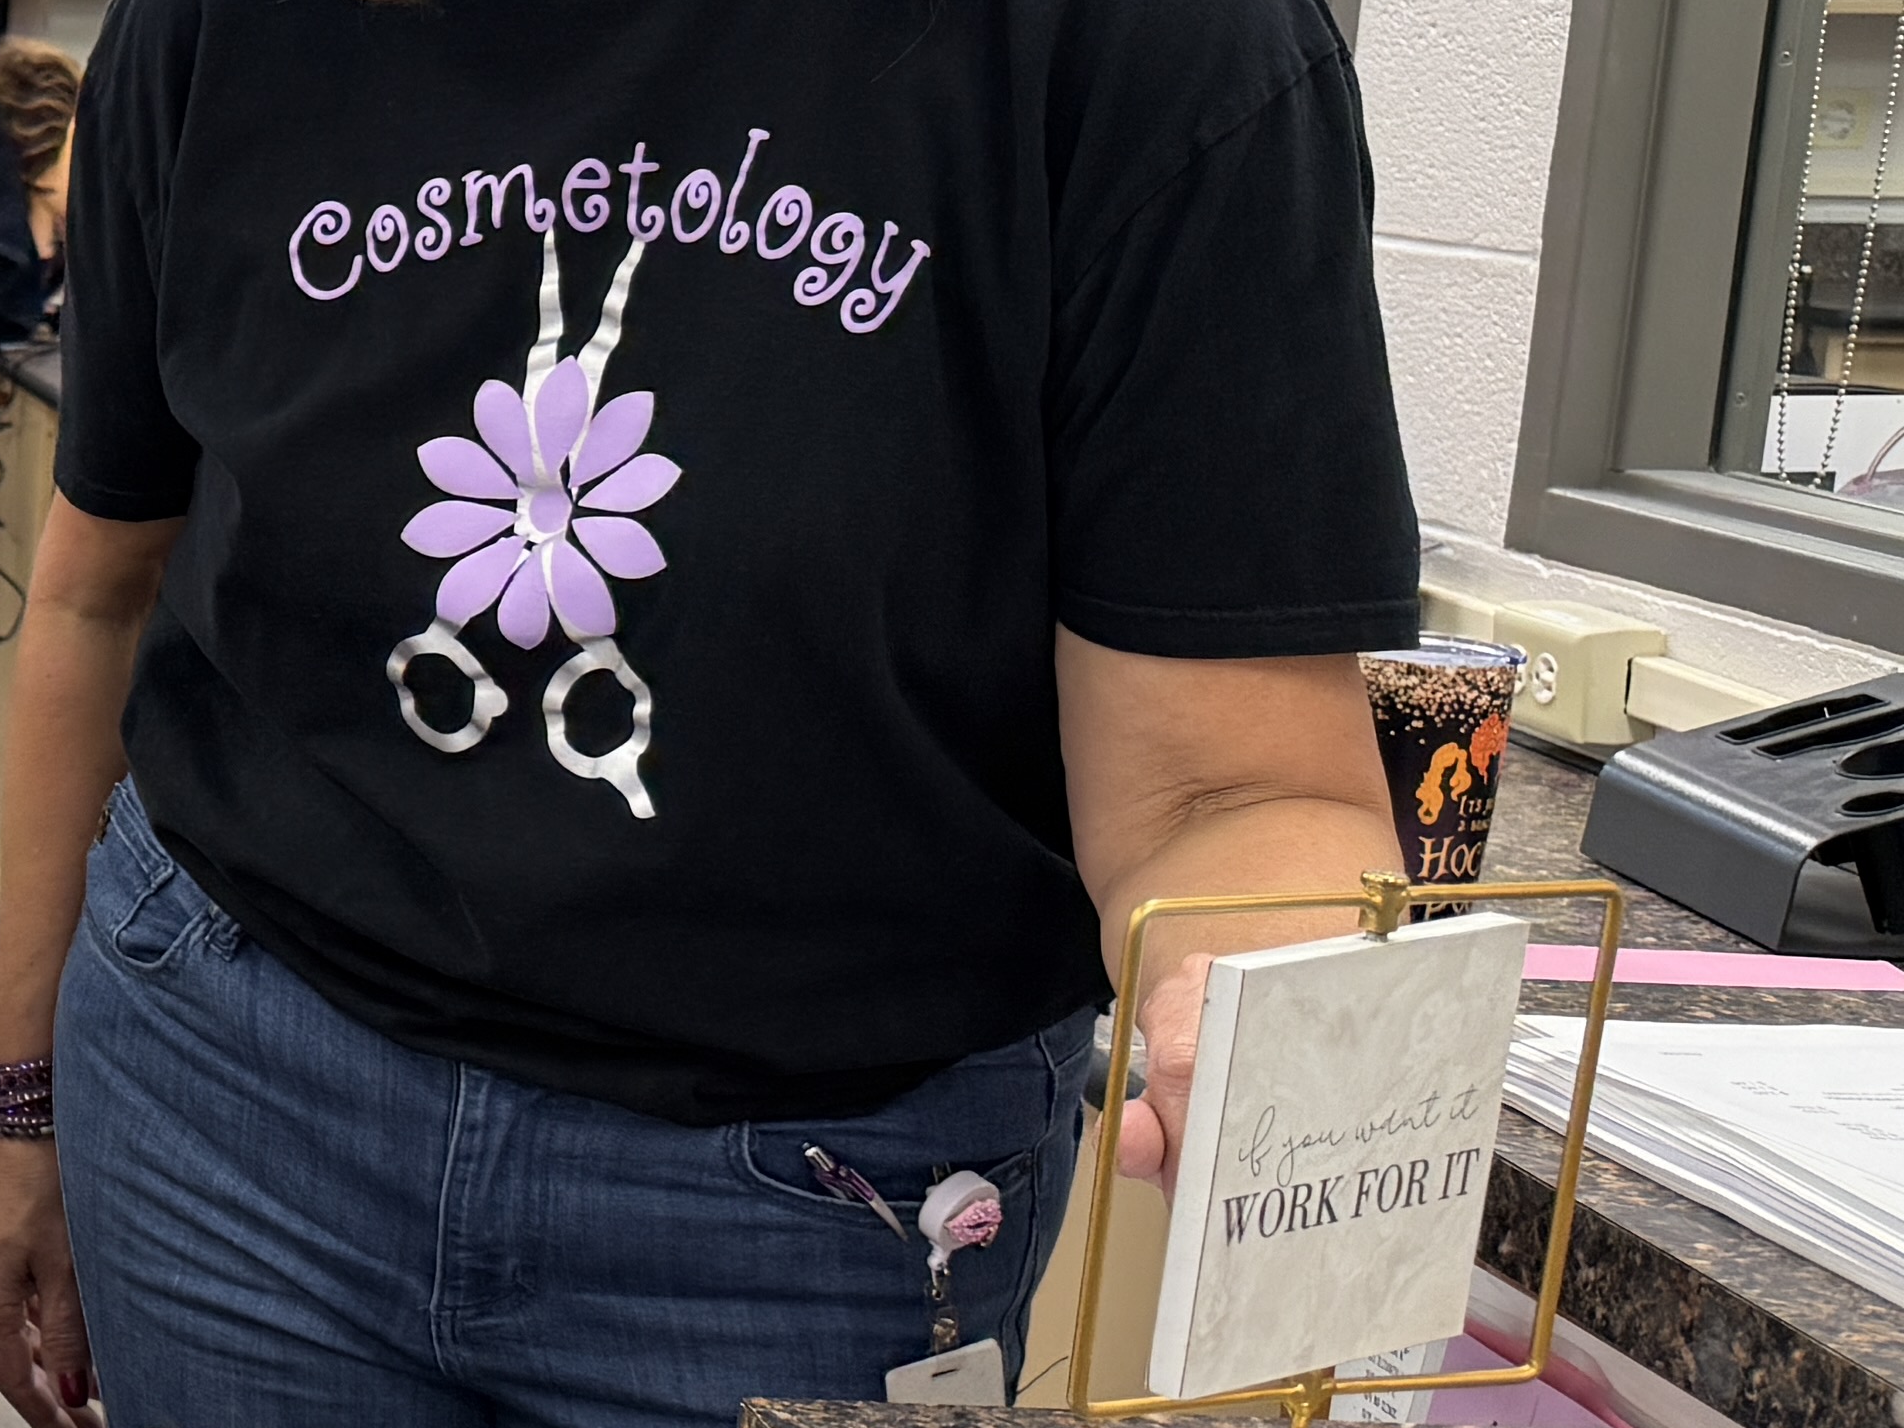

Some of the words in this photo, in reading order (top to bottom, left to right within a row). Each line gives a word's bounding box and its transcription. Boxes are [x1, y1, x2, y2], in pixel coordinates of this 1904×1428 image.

[289, 128, 932, 335] Cosmetology
[1276, 1128, 1348, 1189] you
[1354, 1090, 1440, 1143] want
[1448, 1084, 1481, 1122] it
[1222, 1174, 1342, 1248] WORK
[1349, 1157, 1430, 1219] FOR
[1440, 1147, 1481, 1200] IT
